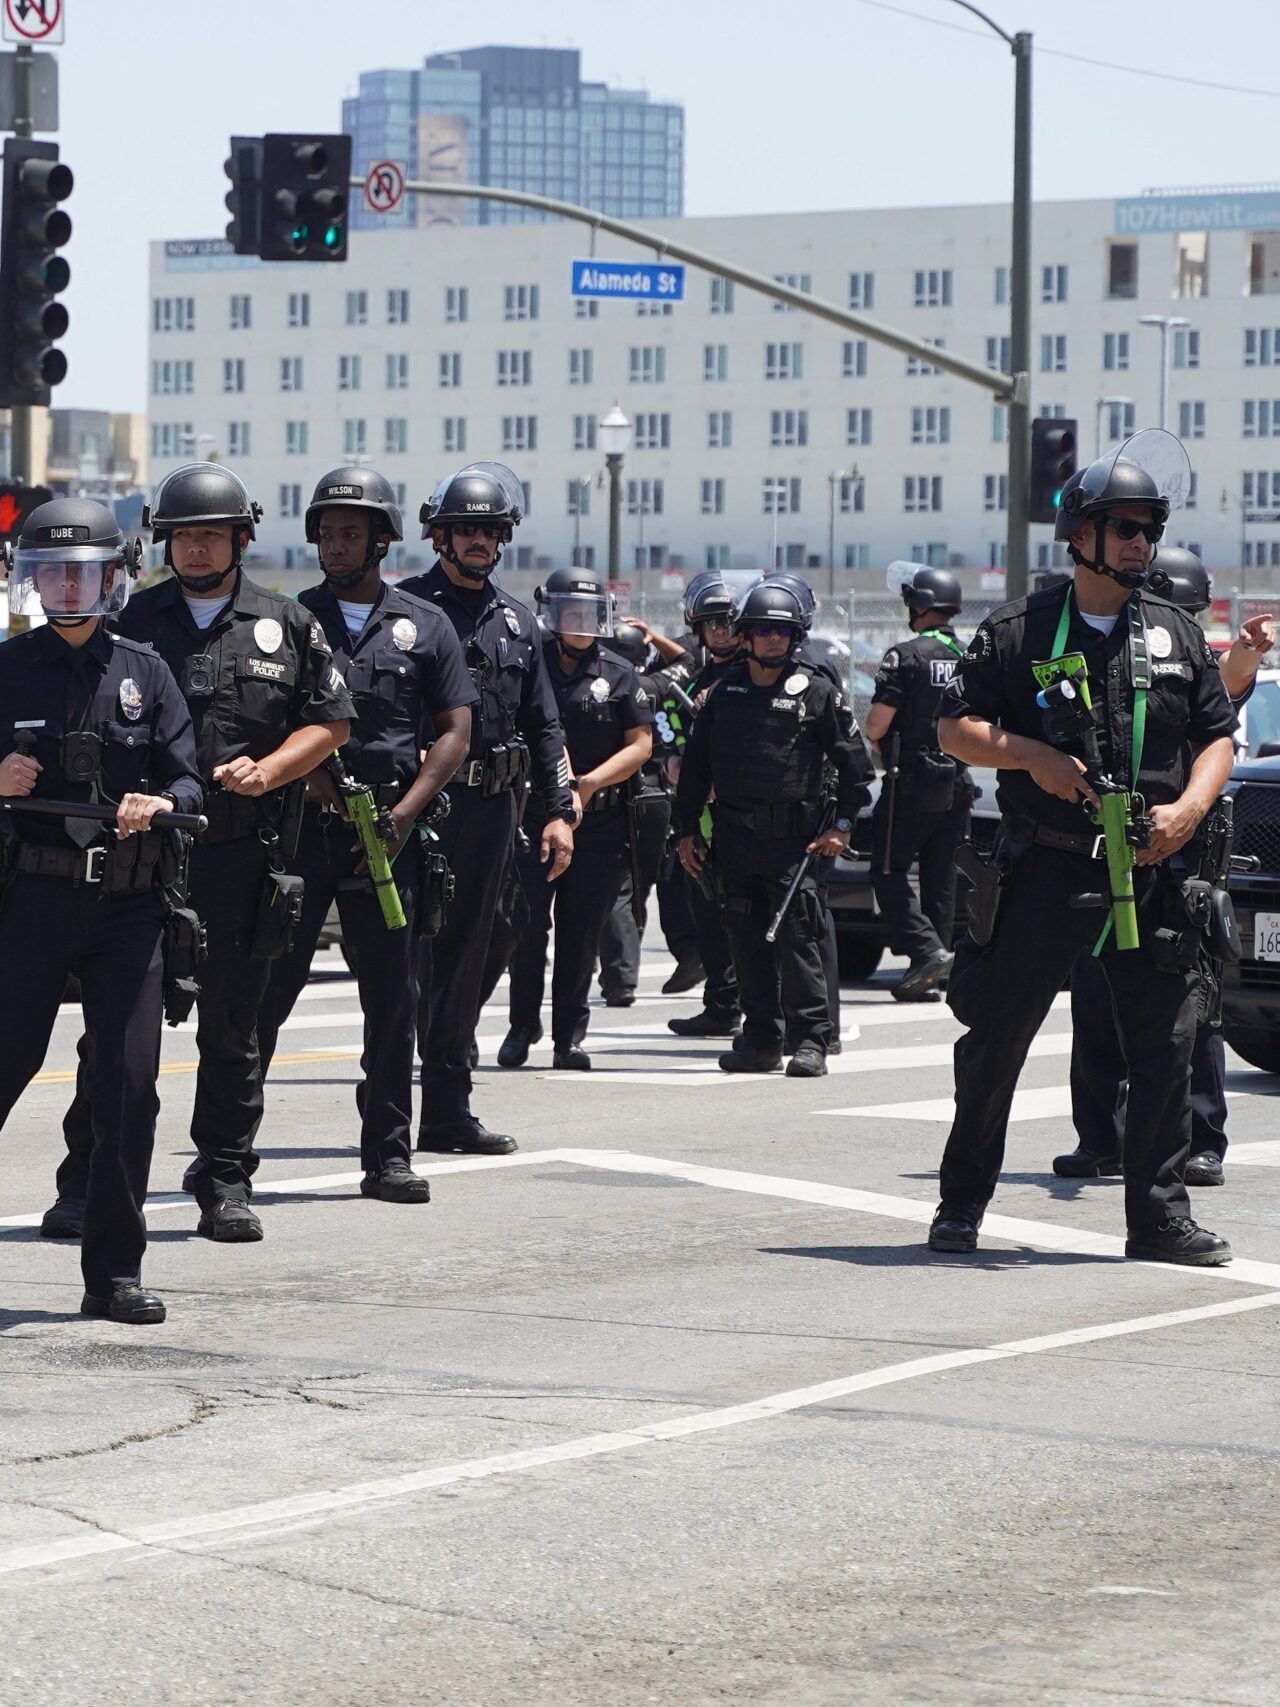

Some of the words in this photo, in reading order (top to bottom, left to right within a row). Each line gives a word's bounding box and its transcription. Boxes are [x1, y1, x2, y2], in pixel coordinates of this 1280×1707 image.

[579, 268, 651, 292] Alameda
[658, 272, 676, 294] St
[329, 486, 353, 495] WILSON
[466, 503, 491, 512] RAMOS
[51, 527, 74, 539] DUBE
[249, 658, 261, 667] LOS
[261, 660, 285, 672] ANGELES
[253, 666, 280, 679] POLICE
